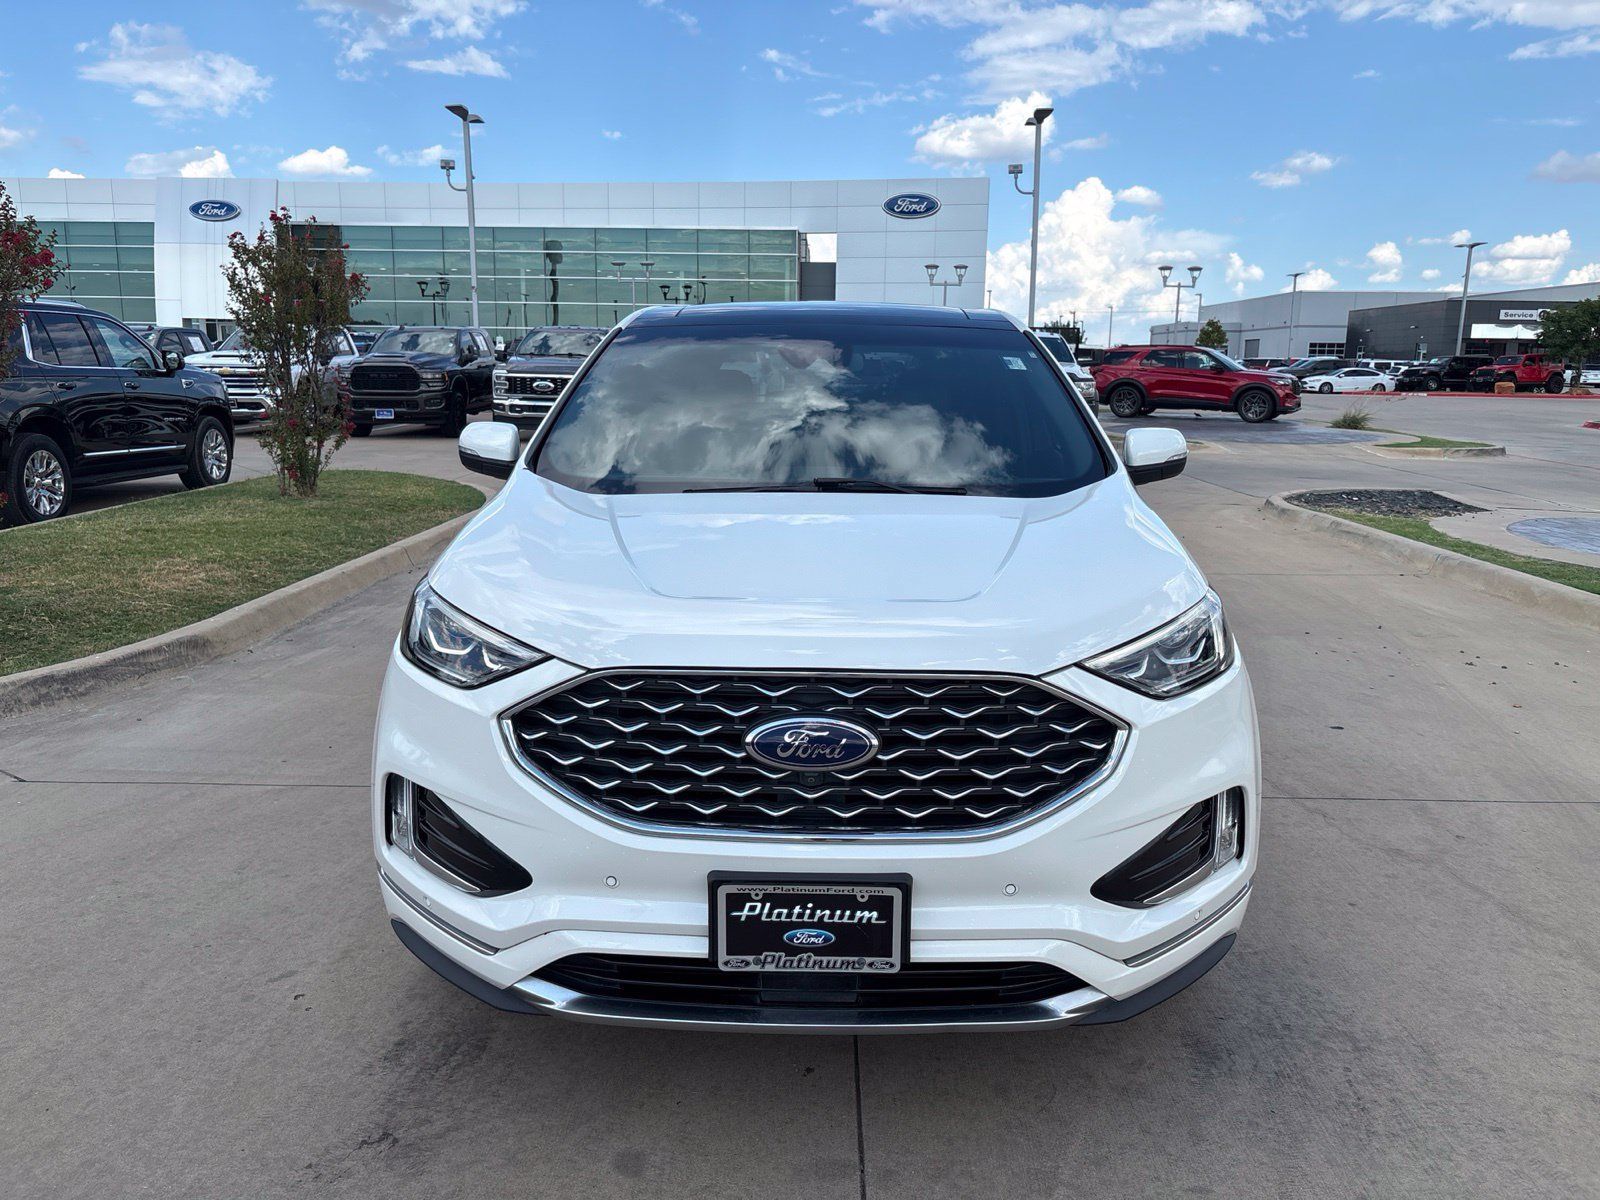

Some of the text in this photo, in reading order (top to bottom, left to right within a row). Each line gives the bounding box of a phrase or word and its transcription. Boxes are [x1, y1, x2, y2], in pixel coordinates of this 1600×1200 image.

[198, 203, 228, 216] Ford
[893, 197, 928, 212] Ford
[776, 729, 847, 759] Ford
[736, 886, 884, 894] www.PlatinumFord.com
[730, 902, 887, 924] Platinum
[793, 930, 826, 945] Ford
[727, 959, 747, 968] Ford
[759, 952, 865, 970] Platinum
[871, 961, 891, 969] Ford
